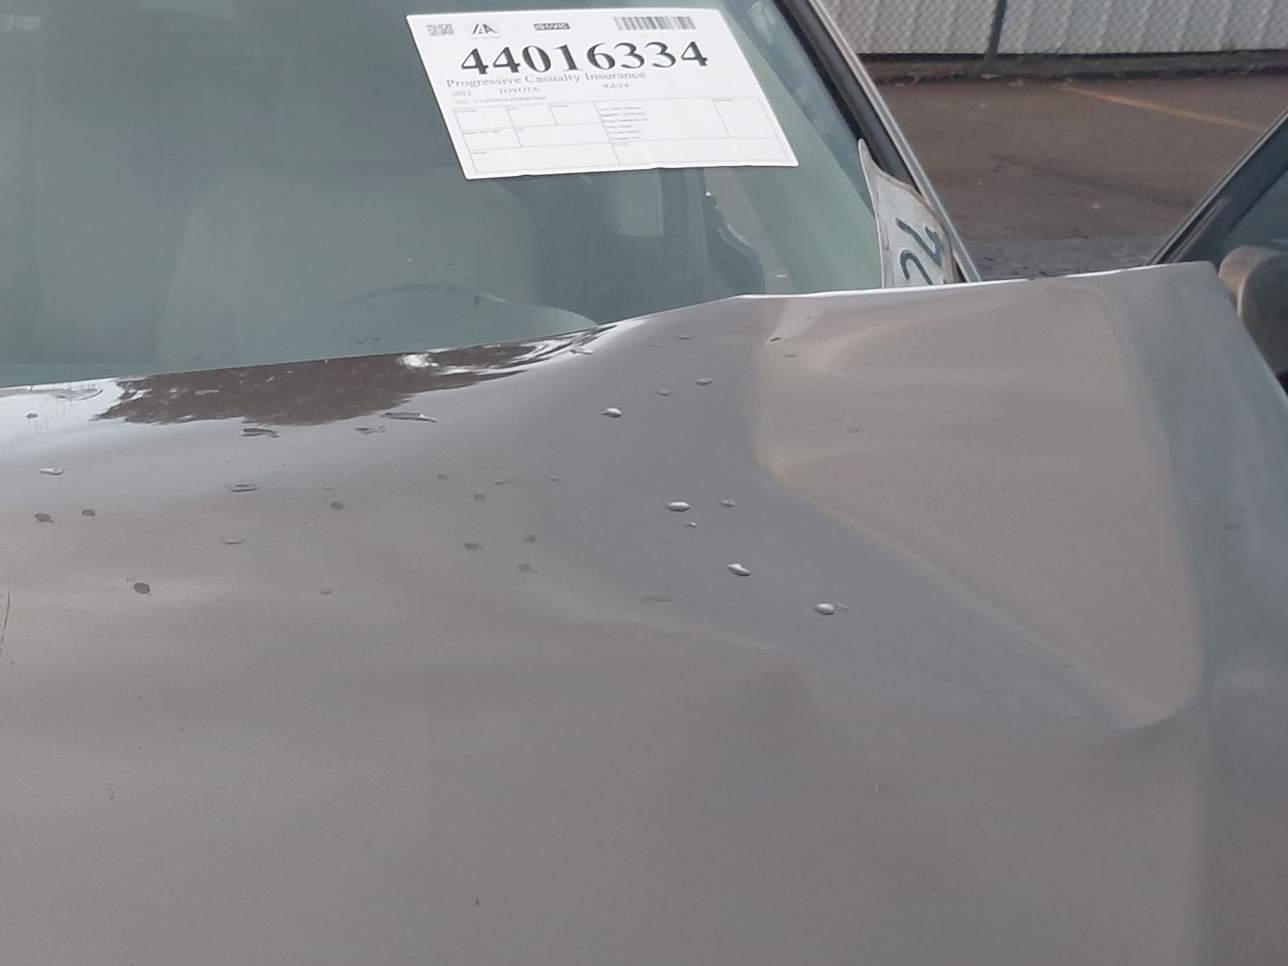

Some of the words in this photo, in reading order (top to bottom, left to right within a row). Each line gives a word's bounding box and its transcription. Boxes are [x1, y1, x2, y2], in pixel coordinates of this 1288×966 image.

[461, 41, 708, 74] 44016334
[446, 77, 521, 88] Progressive
[524, 73, 580, 83] Casualty
[584, 71, 647, 81] Insurance
